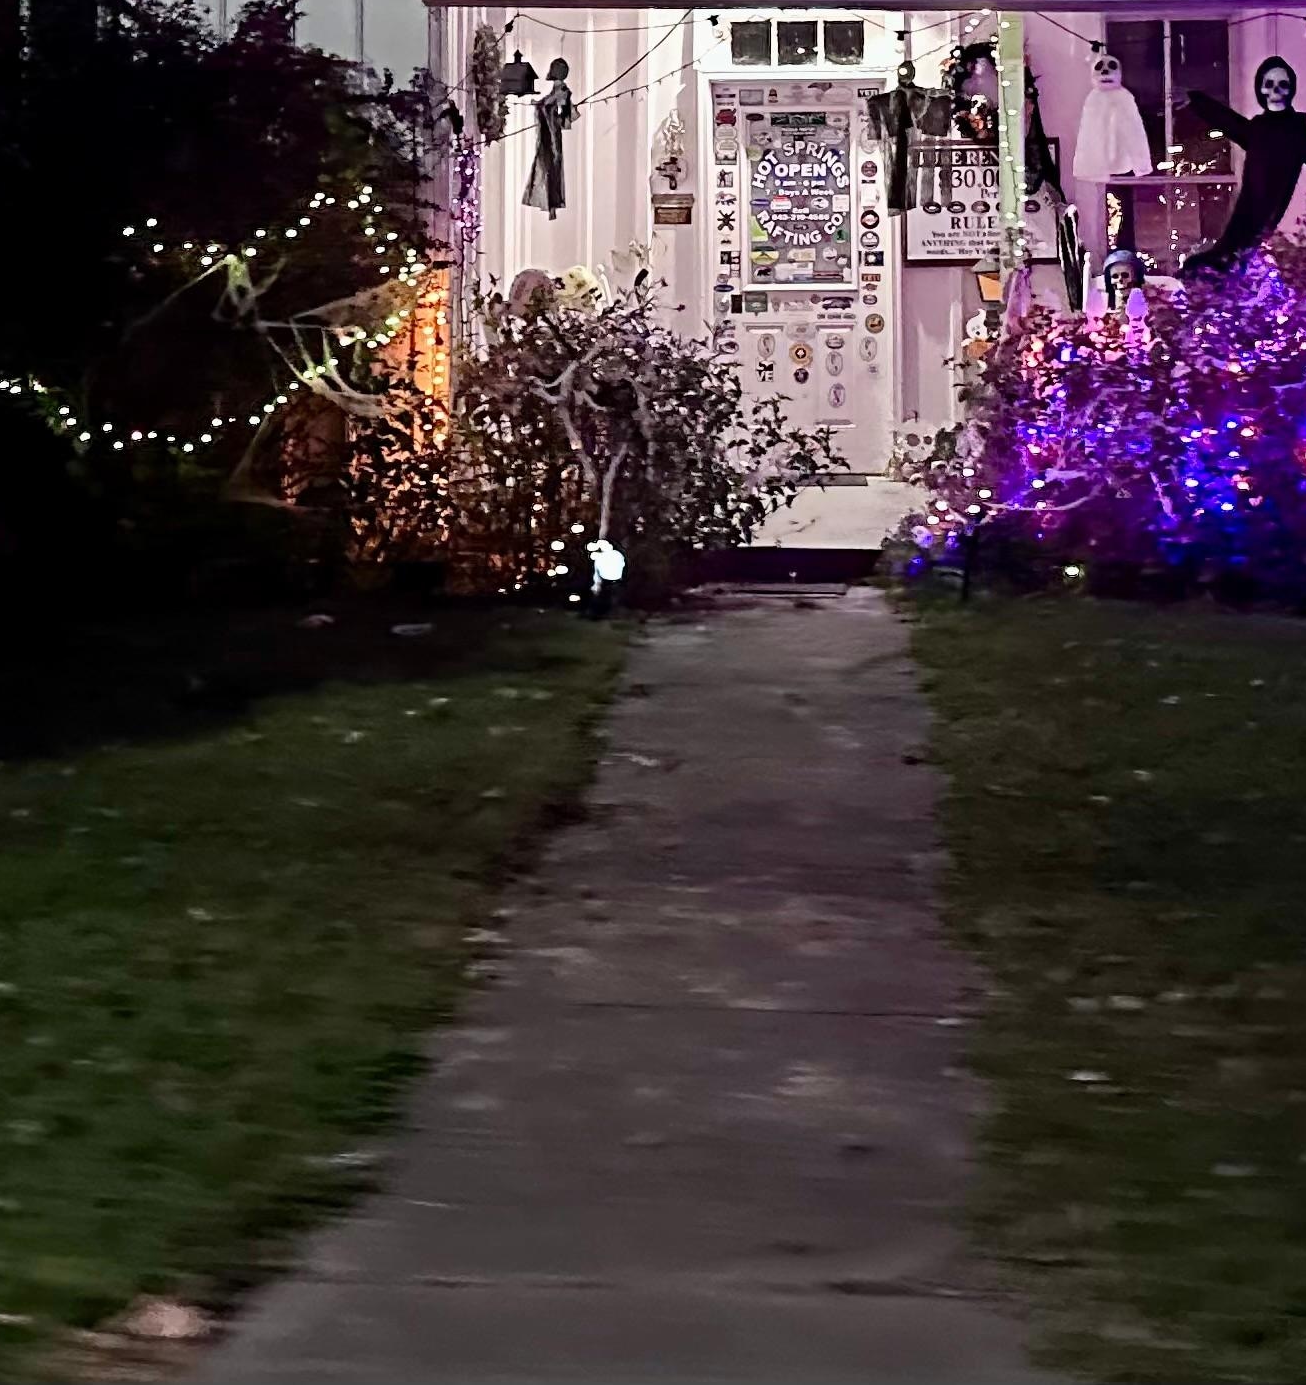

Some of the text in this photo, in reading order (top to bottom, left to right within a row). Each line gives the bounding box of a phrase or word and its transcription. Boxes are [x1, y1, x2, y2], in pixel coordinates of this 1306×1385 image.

[752, 150, 778, 189] HOT
[774, 163, 827, 177] OPEN
[778, 189, 800, 197] Days
[757, 210, 822, 246] RAFTING
